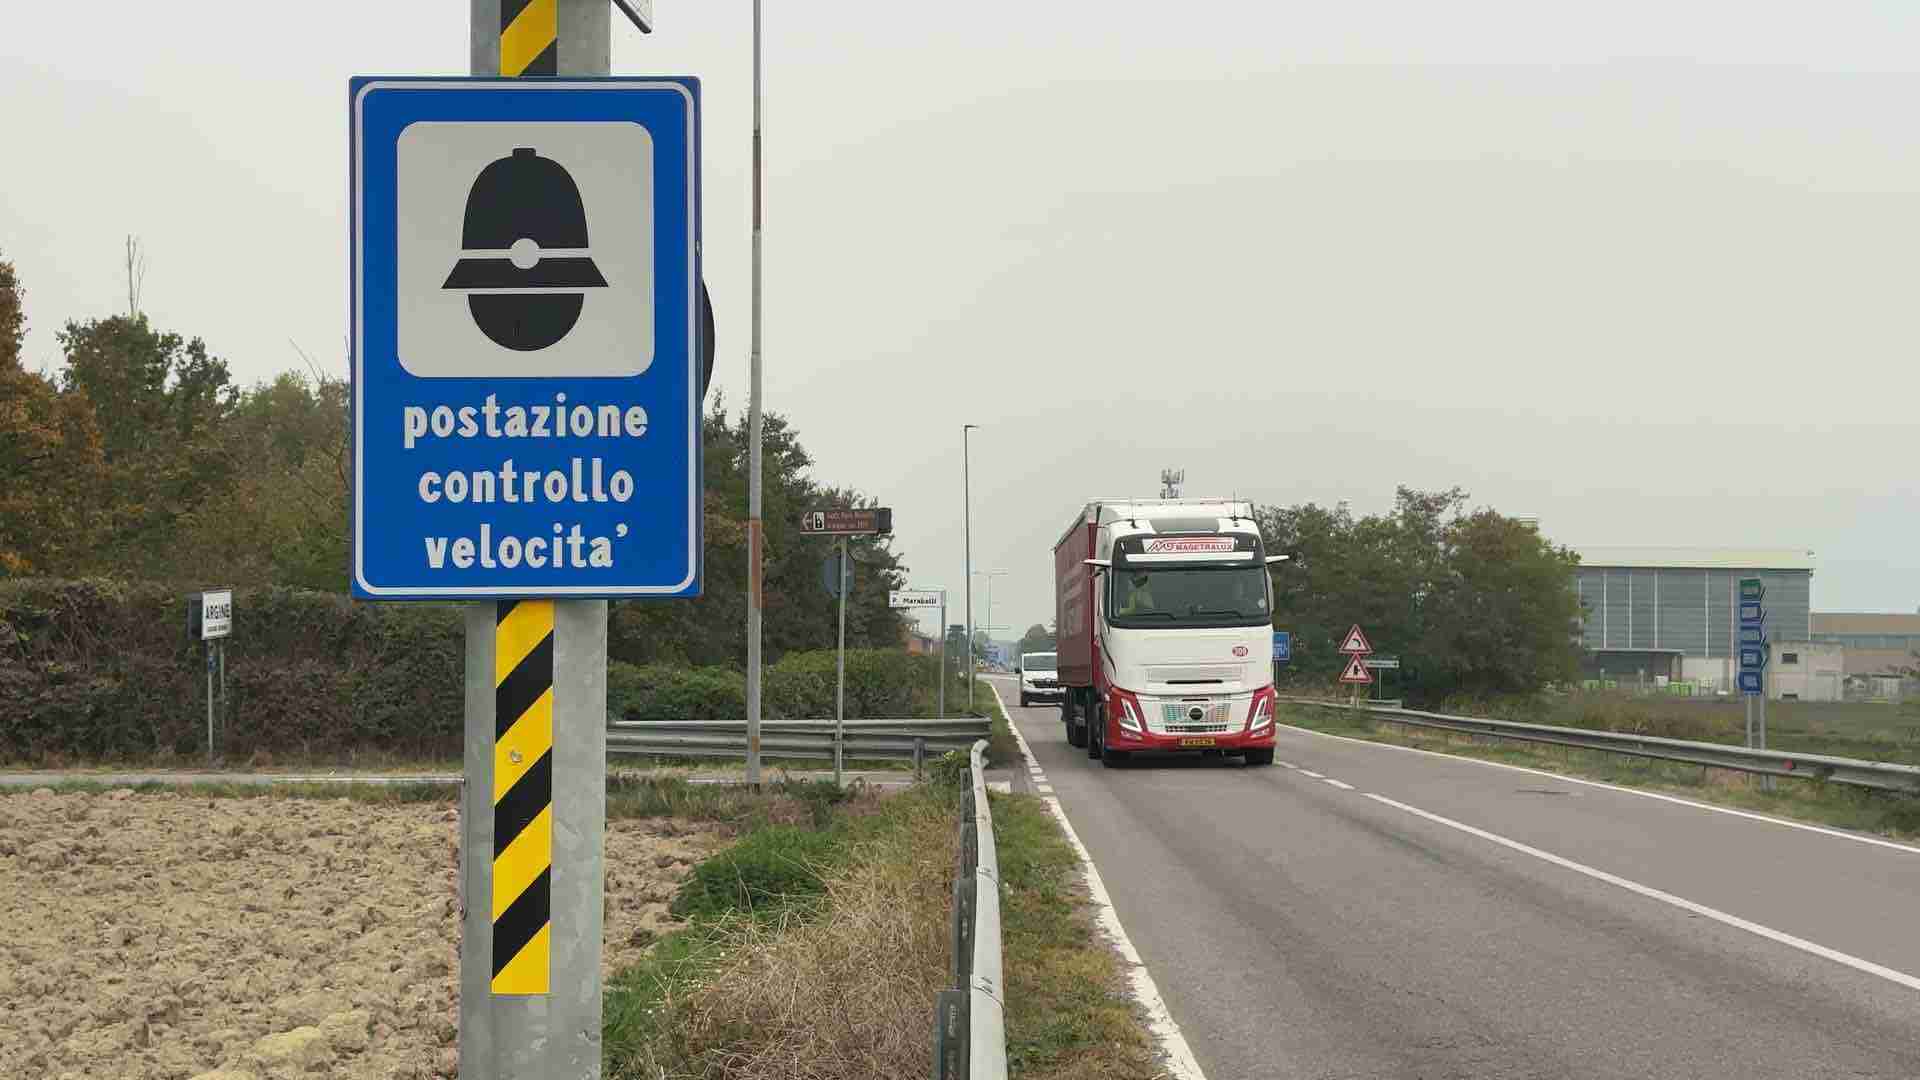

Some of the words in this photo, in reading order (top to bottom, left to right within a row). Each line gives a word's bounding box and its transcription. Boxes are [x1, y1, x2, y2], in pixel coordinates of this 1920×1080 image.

[405, 393, 647, 448] postazione
[419, 458, 633, 502] controllo
[205, 603, 230, 619] ARGINE
